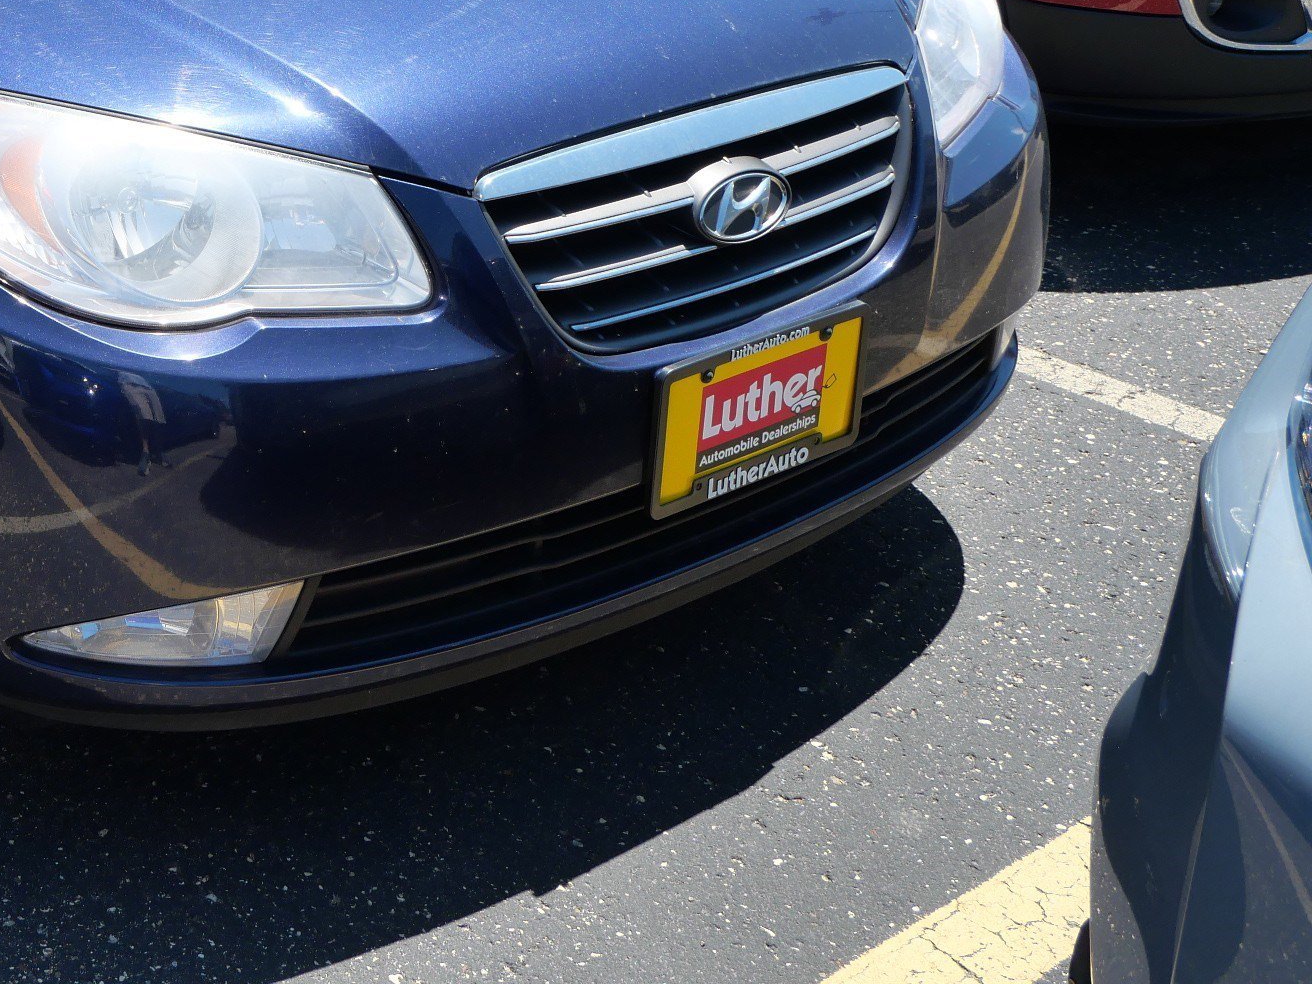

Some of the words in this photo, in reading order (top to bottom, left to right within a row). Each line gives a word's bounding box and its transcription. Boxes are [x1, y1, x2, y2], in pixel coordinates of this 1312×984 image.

[730, 325, 810, 362] LutherAuto.com
[702, 365, 823, 440] Luther
[699, 437, 759, 467] Automobile
[761, 414, 816, 445] Dealerships
[706, 446, 809, 500] LutherAuto
